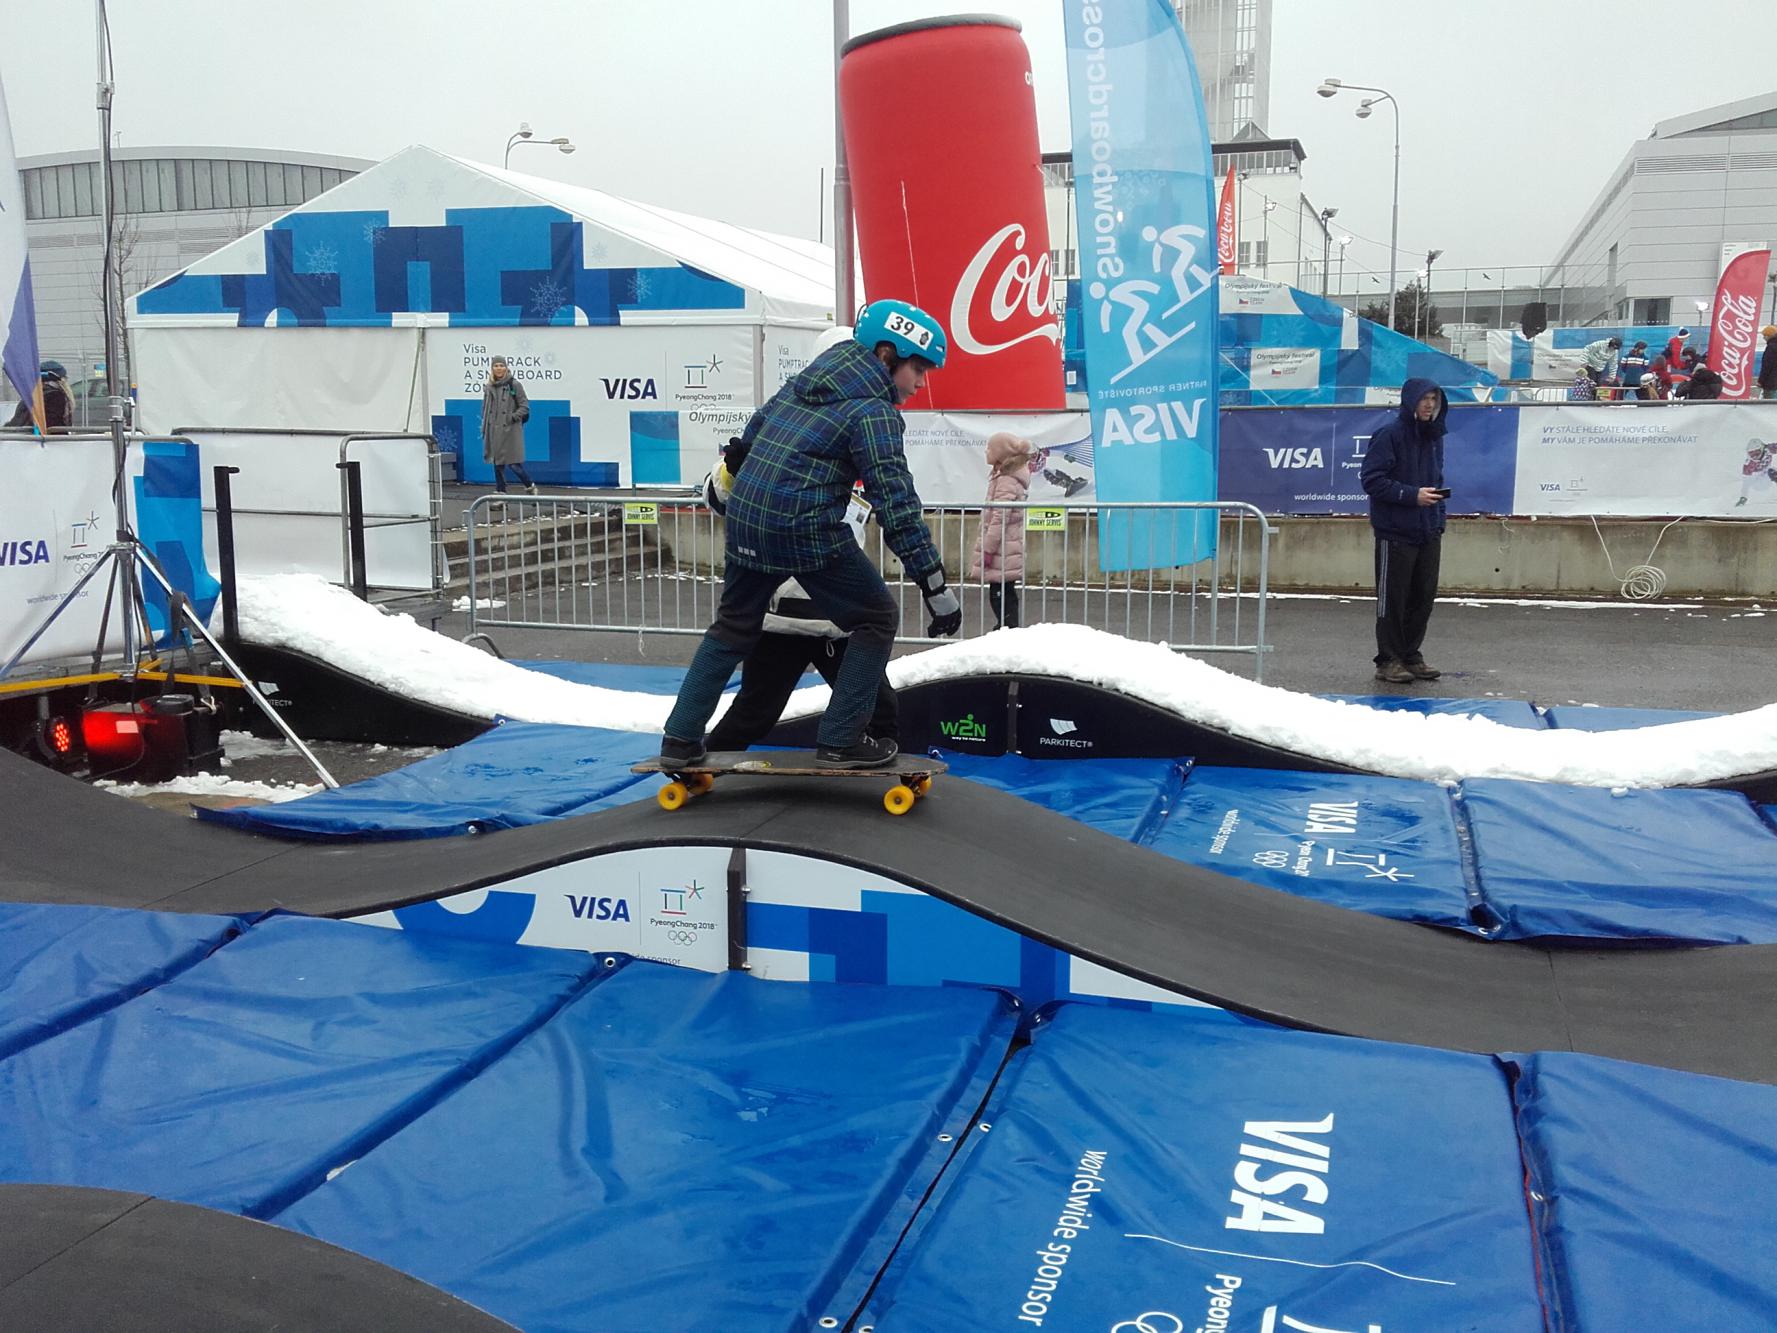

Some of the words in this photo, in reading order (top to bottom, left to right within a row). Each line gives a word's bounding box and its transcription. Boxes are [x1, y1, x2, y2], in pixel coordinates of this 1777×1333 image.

[890, 315, 915, 336] 39
[463, 343, 487, 354] Visa
[463, 356, 541, 367] PUMRACK
[464, 370, 473, 380] A
[477, 370, 562, 380] SNBOARD
[599, 378, 658, 400] VISA
[675, 393, 717, 401] PyeongChang
[717, 393, 732, 401] 2018
[689, 411, 751, 424] Olympijský
[713, 427, 747, 435] PyeongCh
[1543, 425, 1555, 433] VY
[1557, 435, 1576, 444] VÁM
[1577, 436, 1587, 444] JE
[1262, 448, 1324, 468] VISA
[1294, 493, 1336, 501] worldwide
[1337, 494, 1369, 502] sponsor
[1304, 801, 1359, 834] VISA
[564, 894, 631, 922] VISA
[650, 918, 698, 930] PyeongChang
[1224, 1112, 1334, 1235] VISA
[1053, 1150, 1108, 1239] worldwide
[1018, 1242, 1072, 1327] sponsor
